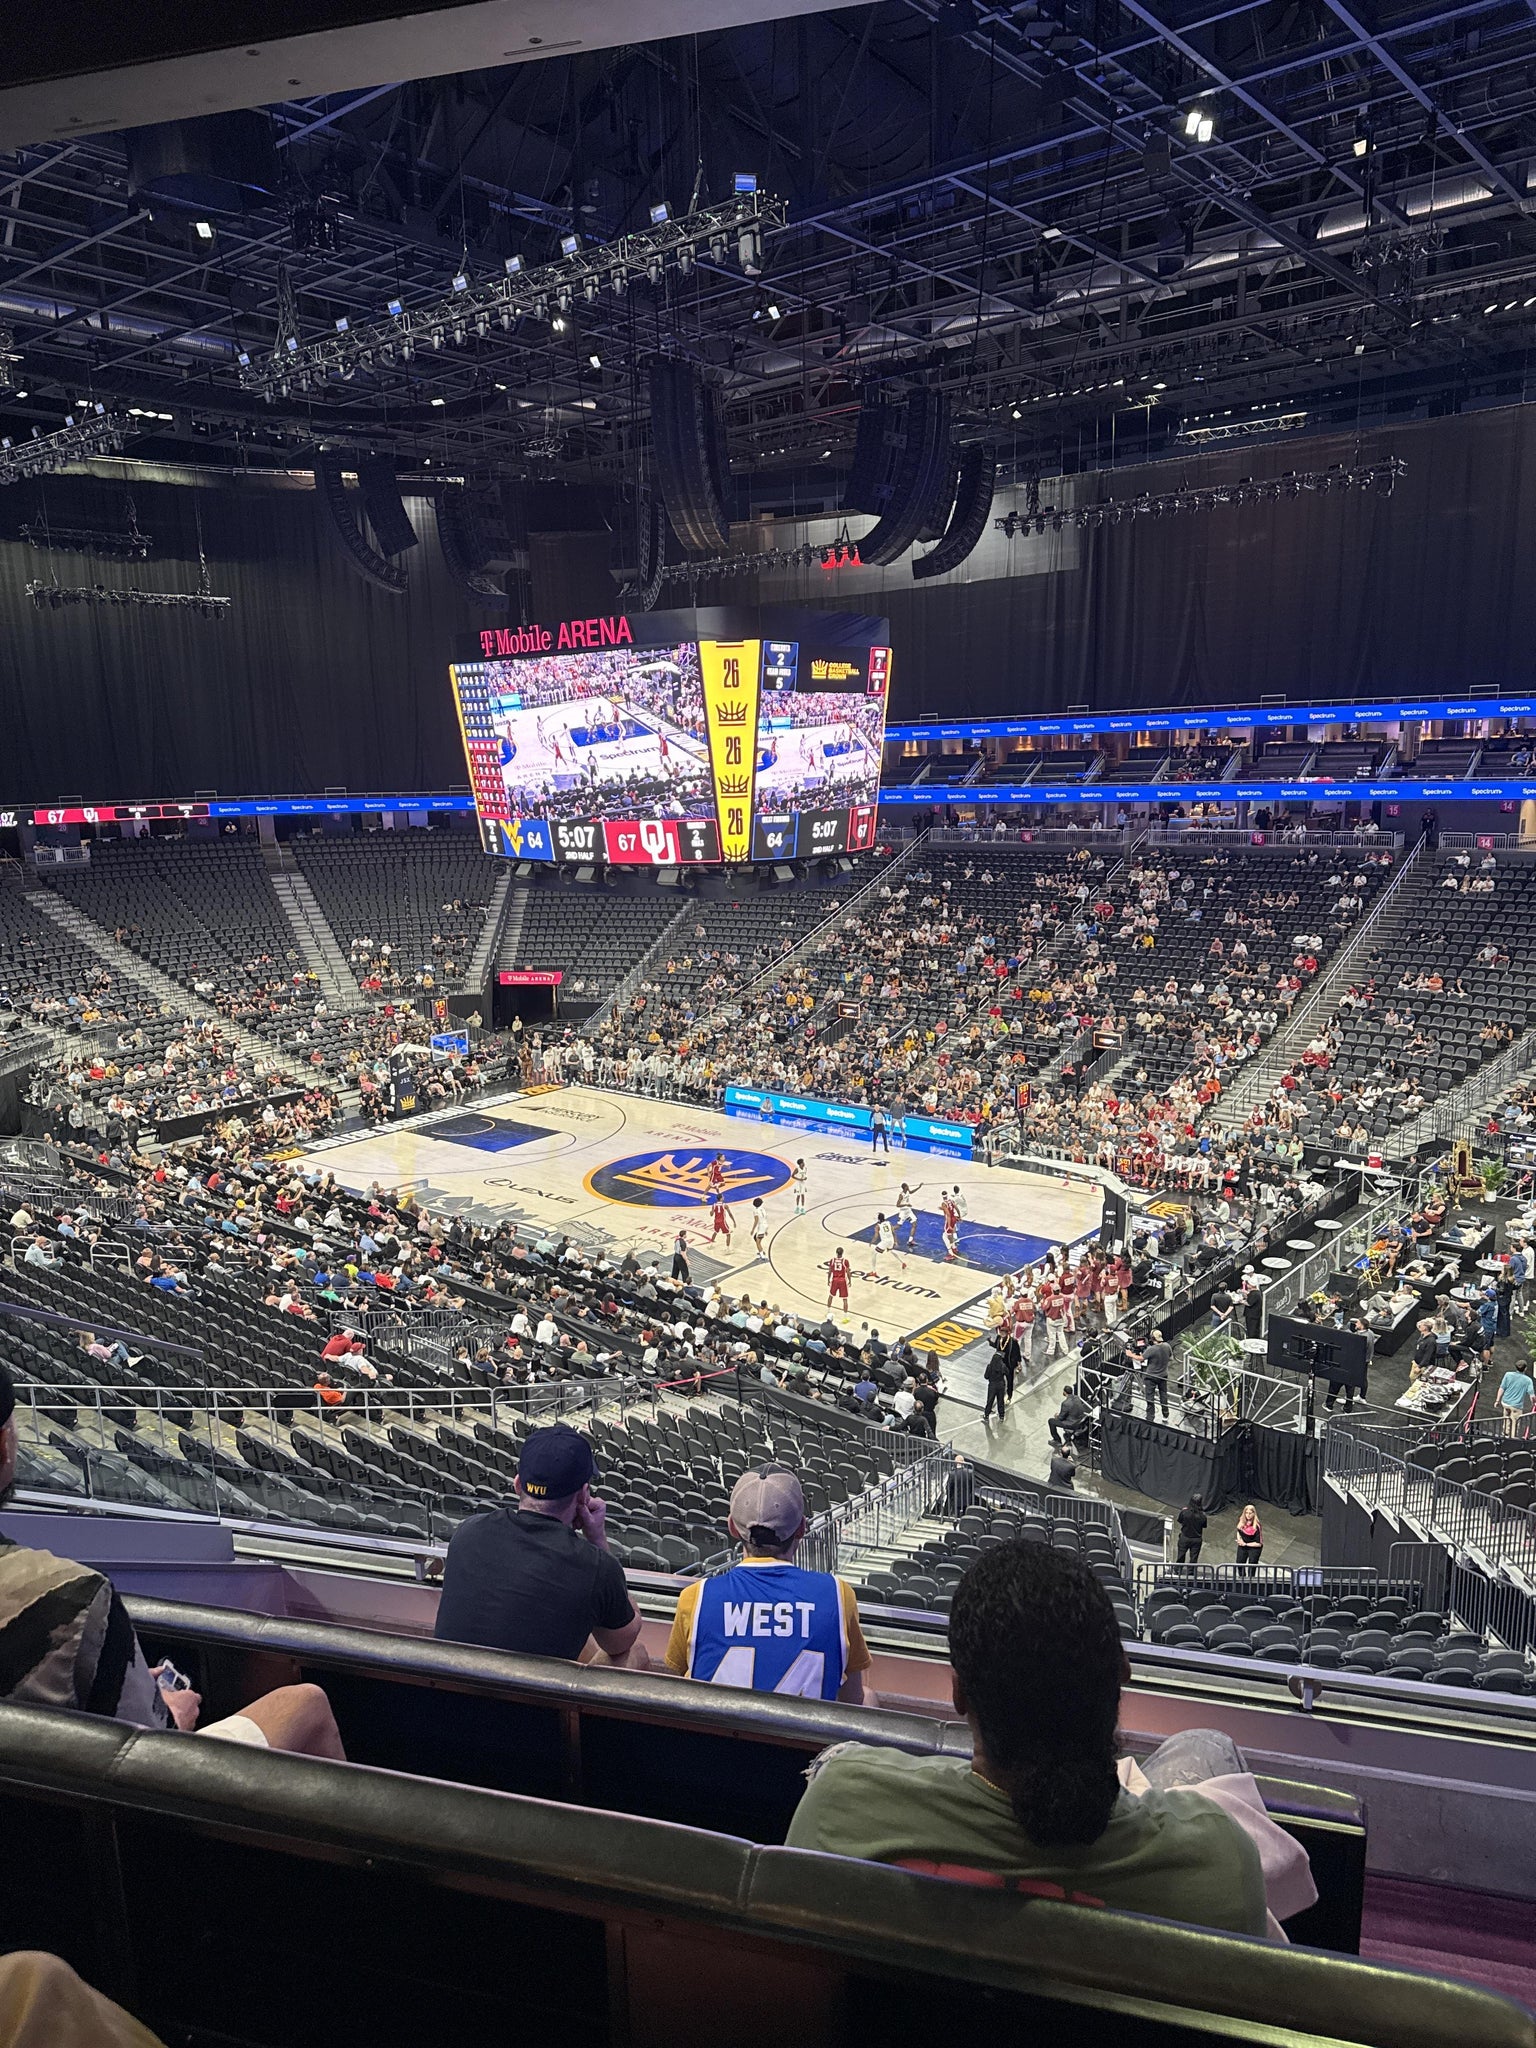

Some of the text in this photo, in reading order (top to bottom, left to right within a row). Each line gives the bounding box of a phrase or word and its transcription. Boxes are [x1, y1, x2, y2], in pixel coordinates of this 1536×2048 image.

[495, 624, 552, 656] Mobile
[557, 616, 634, 650] ARENA
[777, 653, 785, 666] 2
[723, 658, 740, 688] 26
[776, 677, 783, 690] 5
[599, 746, 661, 761] Spectrum
[725, 736, 741, 765] 26
[184, 810, 190, 818] 2
[1389, 806, 1398, 815] 15
[1503, 802, 1513, 811] 14
[48, 810, 65, 824] 67
[728, 808, 743, 836] 26
[489, 826, 495, 835] 2
[558, 826, 595, 848] 5:07
[692, 830, 701, 840] 2
[812, 820, 838, 839] 5:07
[857, 824, 868, 838] 67
[527, 832, 543, 849] 64
[618, 834, 636, 851] 67
[639, 820, 676, 864] OU
[767, 832, 783, 848] 64
[1254, 833, 1262, 843] 15
[578, 852, 594, 860] HALF
[695, 850, 702, 860] 8
[302, 1092, 530, 1150] COLLEGE BASKETBALL CROWN
[735, 1092, 962, 1138] Spectrum Spectrum Spectrum Spectrum
[643, 1130, 691, 1142] ARENA
[508, 1184, 579, 1204] LEXUS
[817, 1260, 937, 1298] Sectrum
[908, 1321, 984, 1356] 2026
[526, 1482, 547, 1496] WVU
[723, 1602, 815, 1639] WEST
